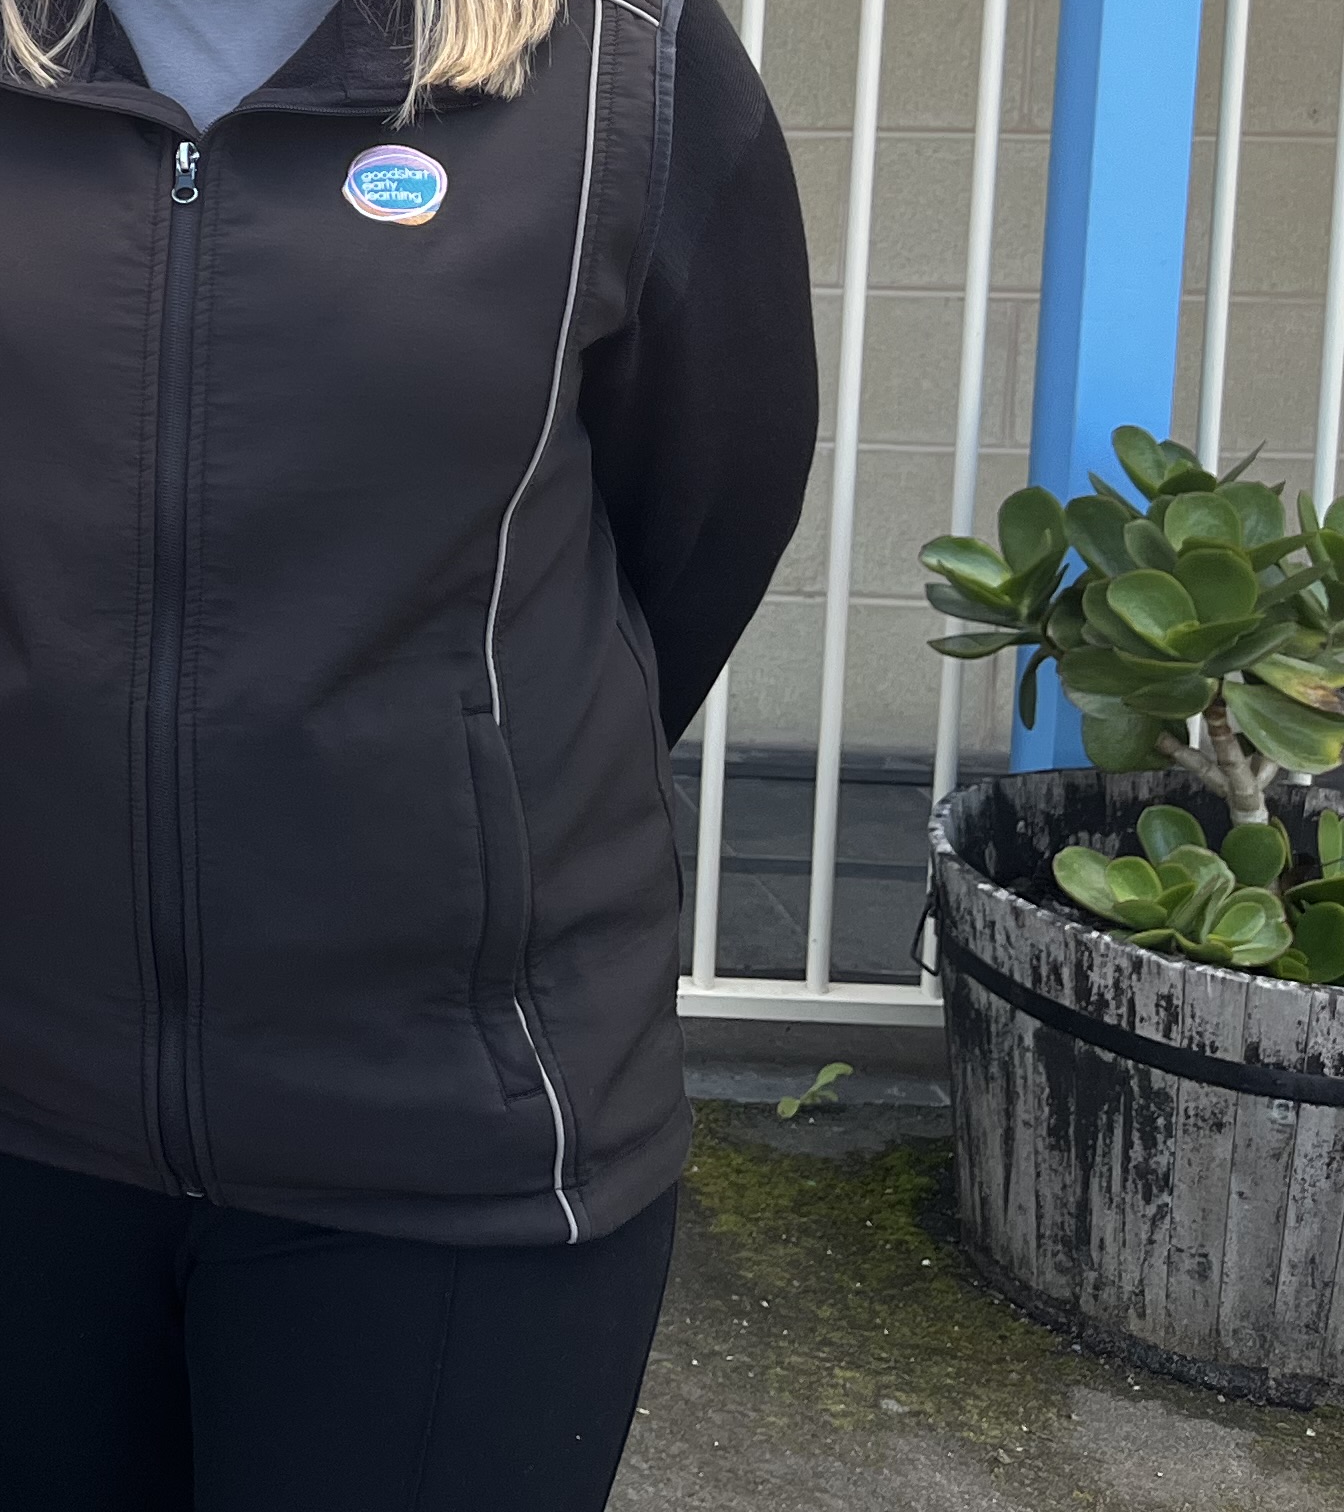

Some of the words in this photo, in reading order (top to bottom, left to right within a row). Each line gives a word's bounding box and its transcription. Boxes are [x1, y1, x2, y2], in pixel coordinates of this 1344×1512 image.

[360, 168, 430, 183] goodstart
[362, 179, 398, 192] early
[364, 188, 423, 204] learning
